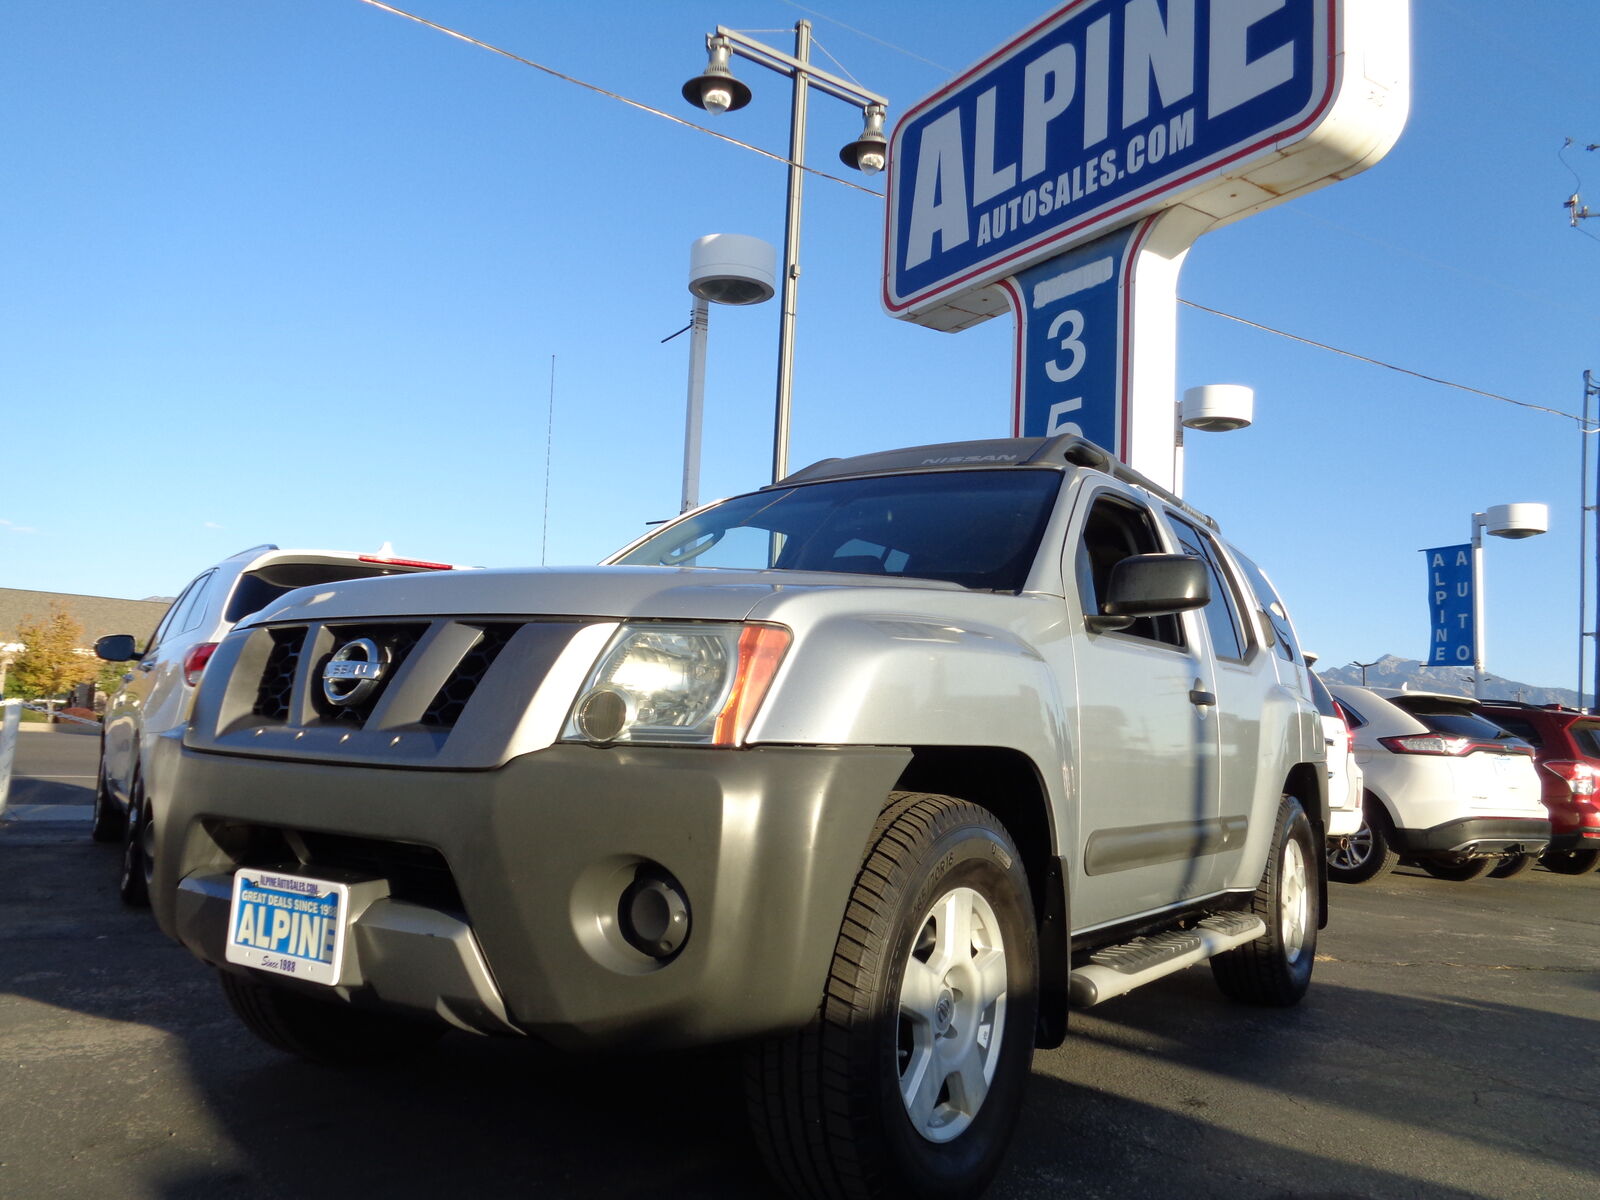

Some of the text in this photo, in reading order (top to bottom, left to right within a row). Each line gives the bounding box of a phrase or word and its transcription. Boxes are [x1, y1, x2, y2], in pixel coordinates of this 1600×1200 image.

[905, 0, 1295, 271] ALPINE
[976, 107, 1195, 247] AUTOSALES.COM
[921, 454, 1017, 465] NISSAN
[1432, 553, 1448, 661] ALPINE
[1455, 550, 1470, 661] AUTO
[236, 903, 337, 964] ALPINE
[241, 890, 267, 904] GREAT
[268, 894, 293, 909] DEALS
[294, 899, 318, 914] SINCE
